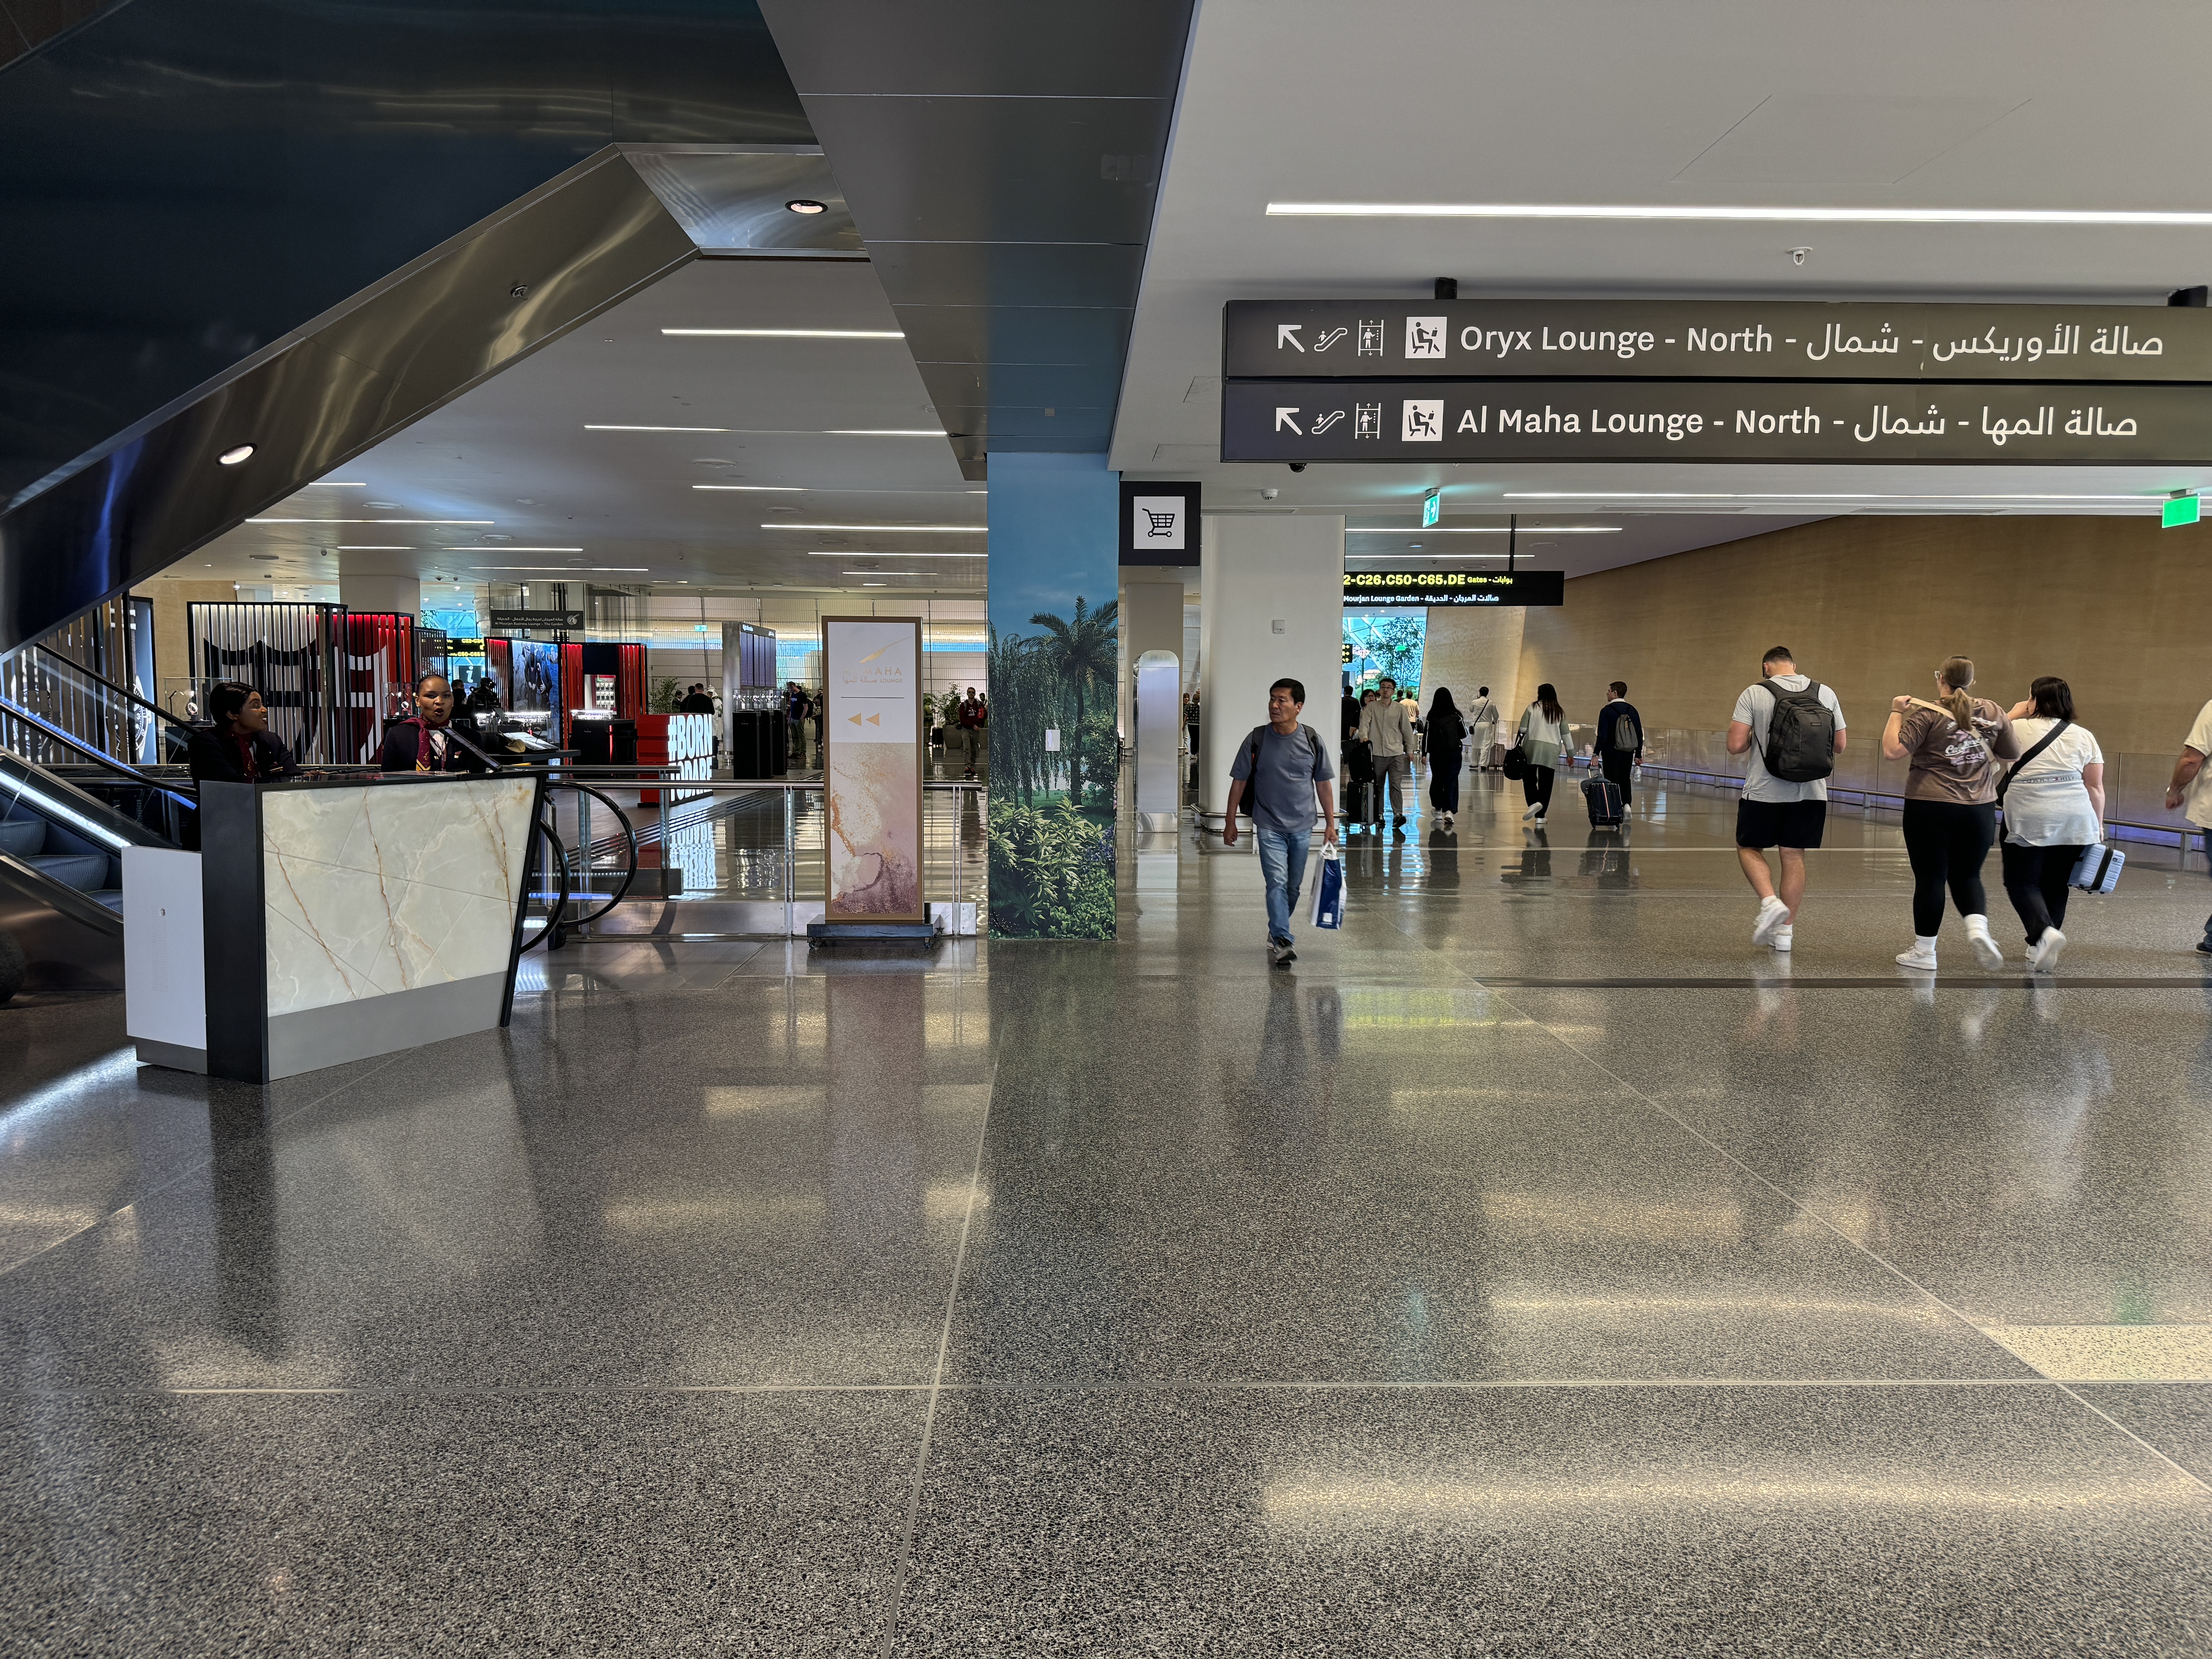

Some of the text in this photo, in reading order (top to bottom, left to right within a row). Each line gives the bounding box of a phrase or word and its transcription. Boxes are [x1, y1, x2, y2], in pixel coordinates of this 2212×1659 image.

[1461, 326, 1532, 359] Oryx
[1543, 327, 1654, 358] Lounge
[1688, 325, 1772, 352] North
[1807, 323, 1898, 361] شمال
[1933, 323, 2080, 362] الأوريكس
[2090, 326, 2163, 355] صالة
[1457, 405, 1487, 433] Al
[1499, 405, 1581, 433] Maha
[1592, 409, 1703, 441] Lounge
[1736, 406, 1820, 434] North
[1854, 404, 1945, 442] شمال
[1982, 406, 2054, 446] المها
[2065, 407, 2137, 436] صالة
[1343, 595, 1370, 603] Mourjan
[842, 676, 857, 685] المها
[863, 667, 902, 675] MAHA
[668, 714, 713, 761] #BORN
